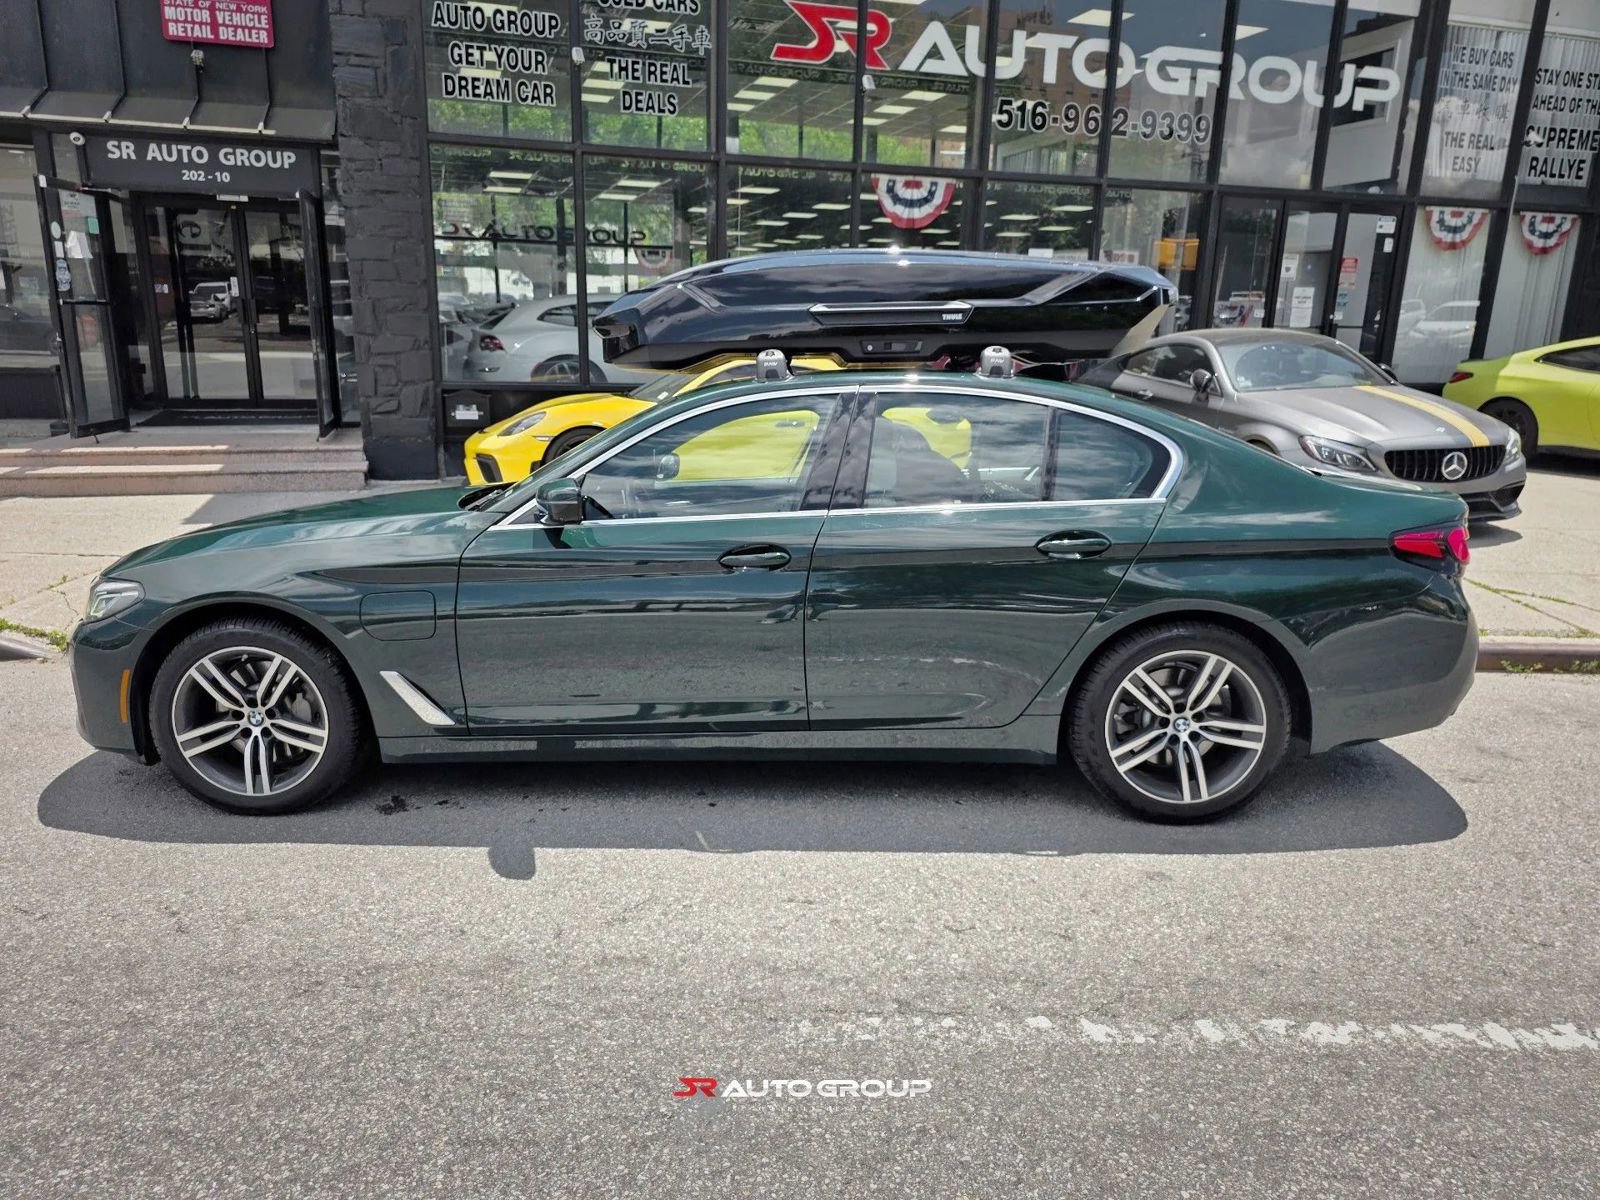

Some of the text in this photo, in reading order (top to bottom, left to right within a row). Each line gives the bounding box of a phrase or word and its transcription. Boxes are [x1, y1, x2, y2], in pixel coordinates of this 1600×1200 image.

[164, 6, 269, 28] MOTOR VEHICLE
[215, 2, 237, 11] NEW
[240, 5, 268, 13] YORK
[432, 1, 560, 38] AUTO GROUP
[168, 22, 268, 43] RETAIL DEALER
[448, 40, 548, 75] GET YOUR
[899, 20, 1136, 90] AUTO
[1145, 45, 1400, 112] GROUP
[1468, 47, 1488, 66] BUY
[1489, 49, 1514, 69] CARS
[605, 56, 643, 83] THE
[645, 60, 692, 88] REAL
[1453, 71, 1471, 89] THE
[1472, 72, 1498, 92] SAME
[1499, 76, 1518, 93] DAY
[1535, 67, 1561, 86] STAY
[1563, 70, 1585, 88] ONE
[442, 73, 556, 107] DREAM CAR
[620, 89, 678, 116] DEALS
[1532, 95, 1567, 113] AHEAD
[1569, 97, 1583, 114] OF
[994, 99, 1211, 144] 516-962-9399
[1444, 131, 1495, 151] THE REAL
[106, 140, 296, 169] SR AUTO GROUP
[1452, 156, 1481, 174] EASY
[182, 170, 230, 183] 202-10
[1528, 156, 1586, 180] RALLYE
